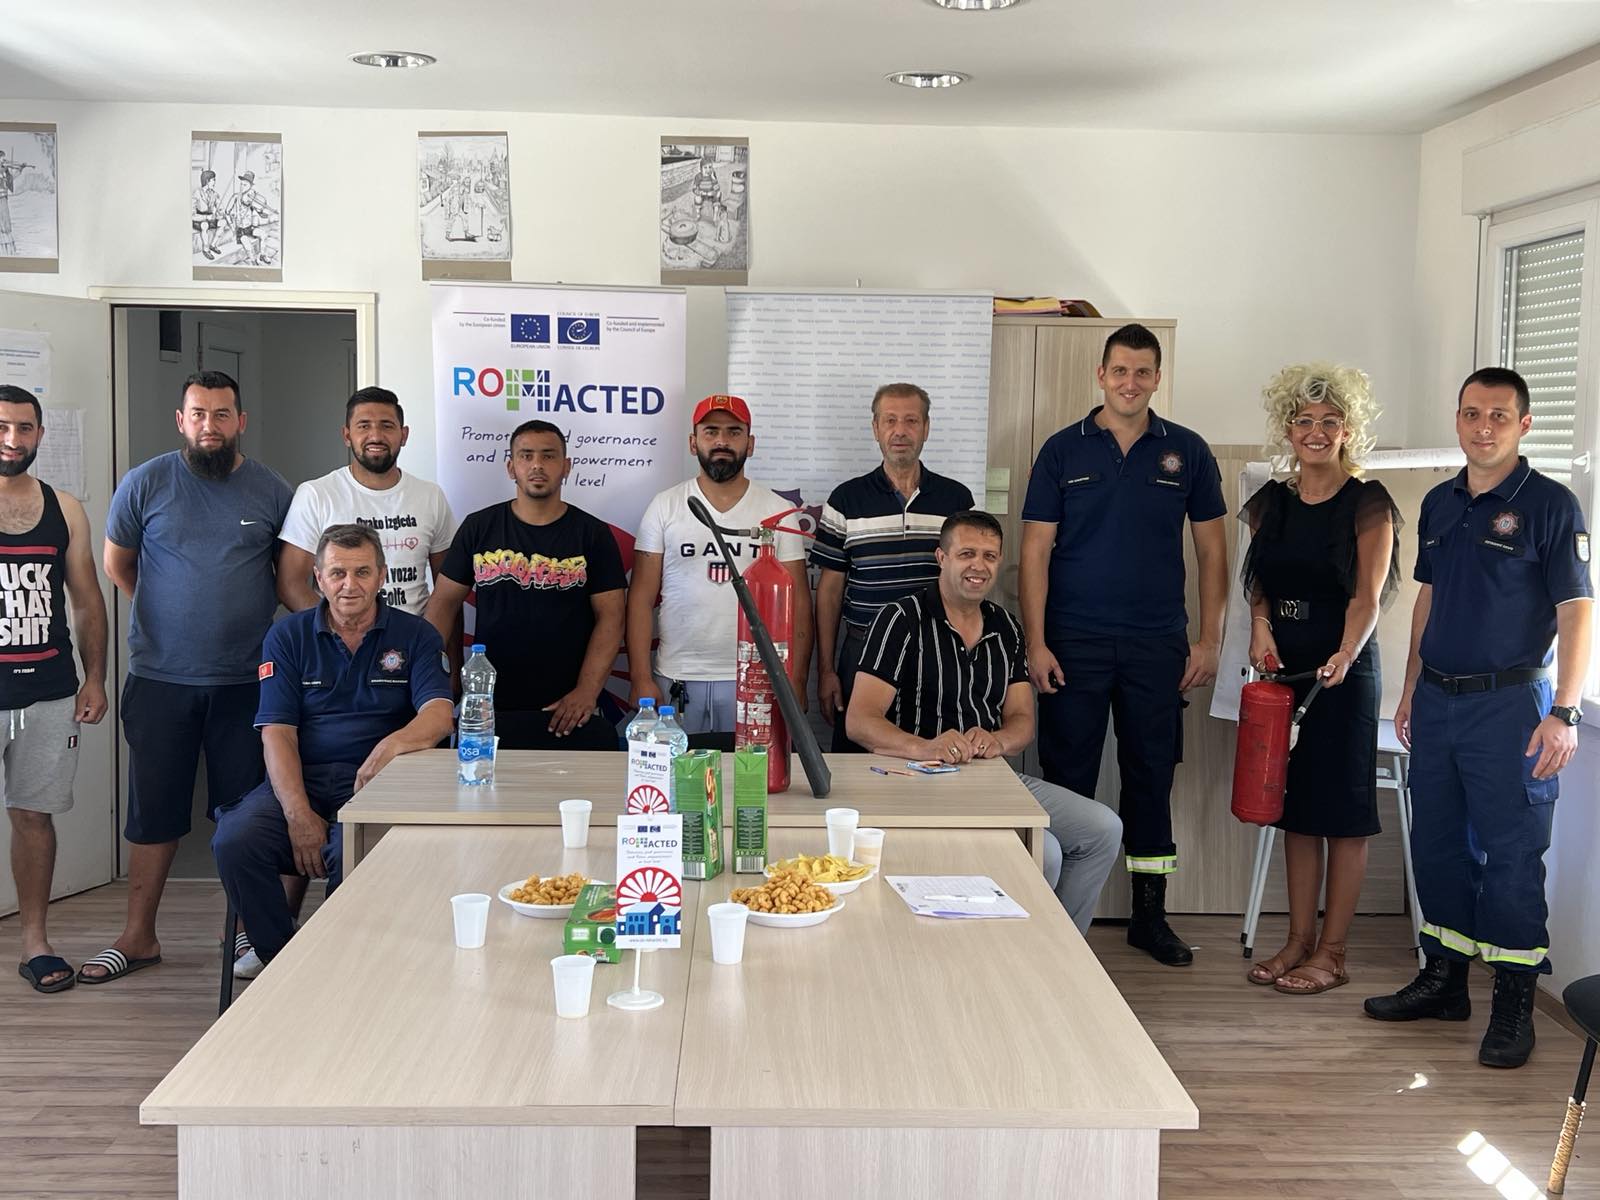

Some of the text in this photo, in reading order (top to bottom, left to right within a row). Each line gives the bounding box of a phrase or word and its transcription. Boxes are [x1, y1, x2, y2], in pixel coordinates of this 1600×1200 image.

[461, 426, 510, 442] Promot
[575, 433, 657, 448] governance
[466, 449, 497, 463] and
[572, 456, 653, 469] powerment
[575, 473, 606, 487] level
[385, 514, 417, 531] izgleda
[680, 542, 761, 558] GANT
[0, 563, 52, 591] UCK
